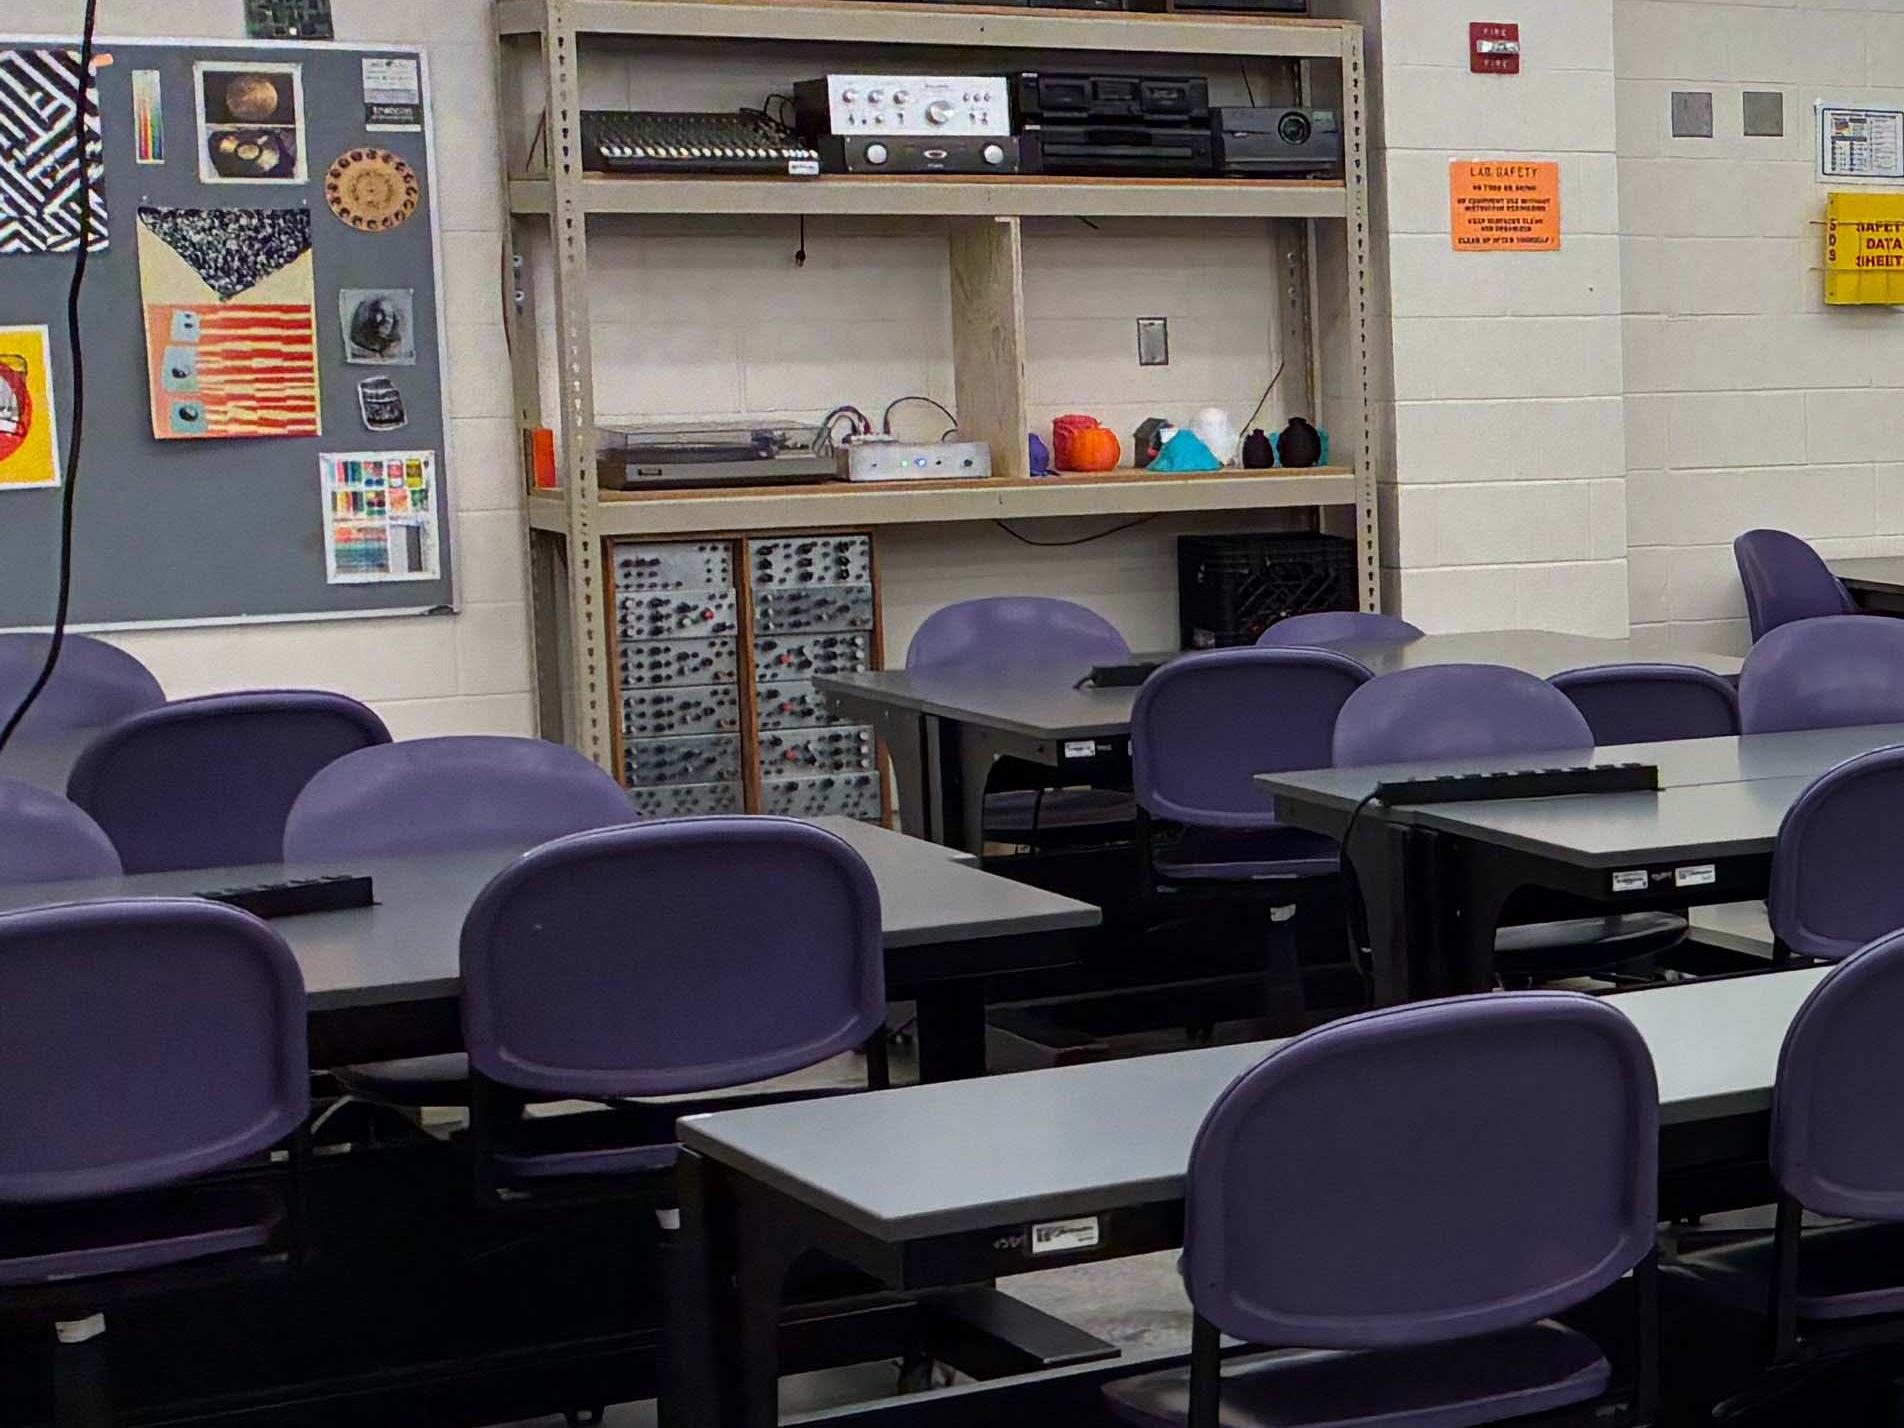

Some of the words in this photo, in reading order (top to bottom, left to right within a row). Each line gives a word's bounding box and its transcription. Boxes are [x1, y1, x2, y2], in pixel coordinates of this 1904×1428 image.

[1470, 167, 1491, 177] LAB
[1496, 167, 1538, 178] SAFETY
[1866, 238, 1903, 250] DATA
